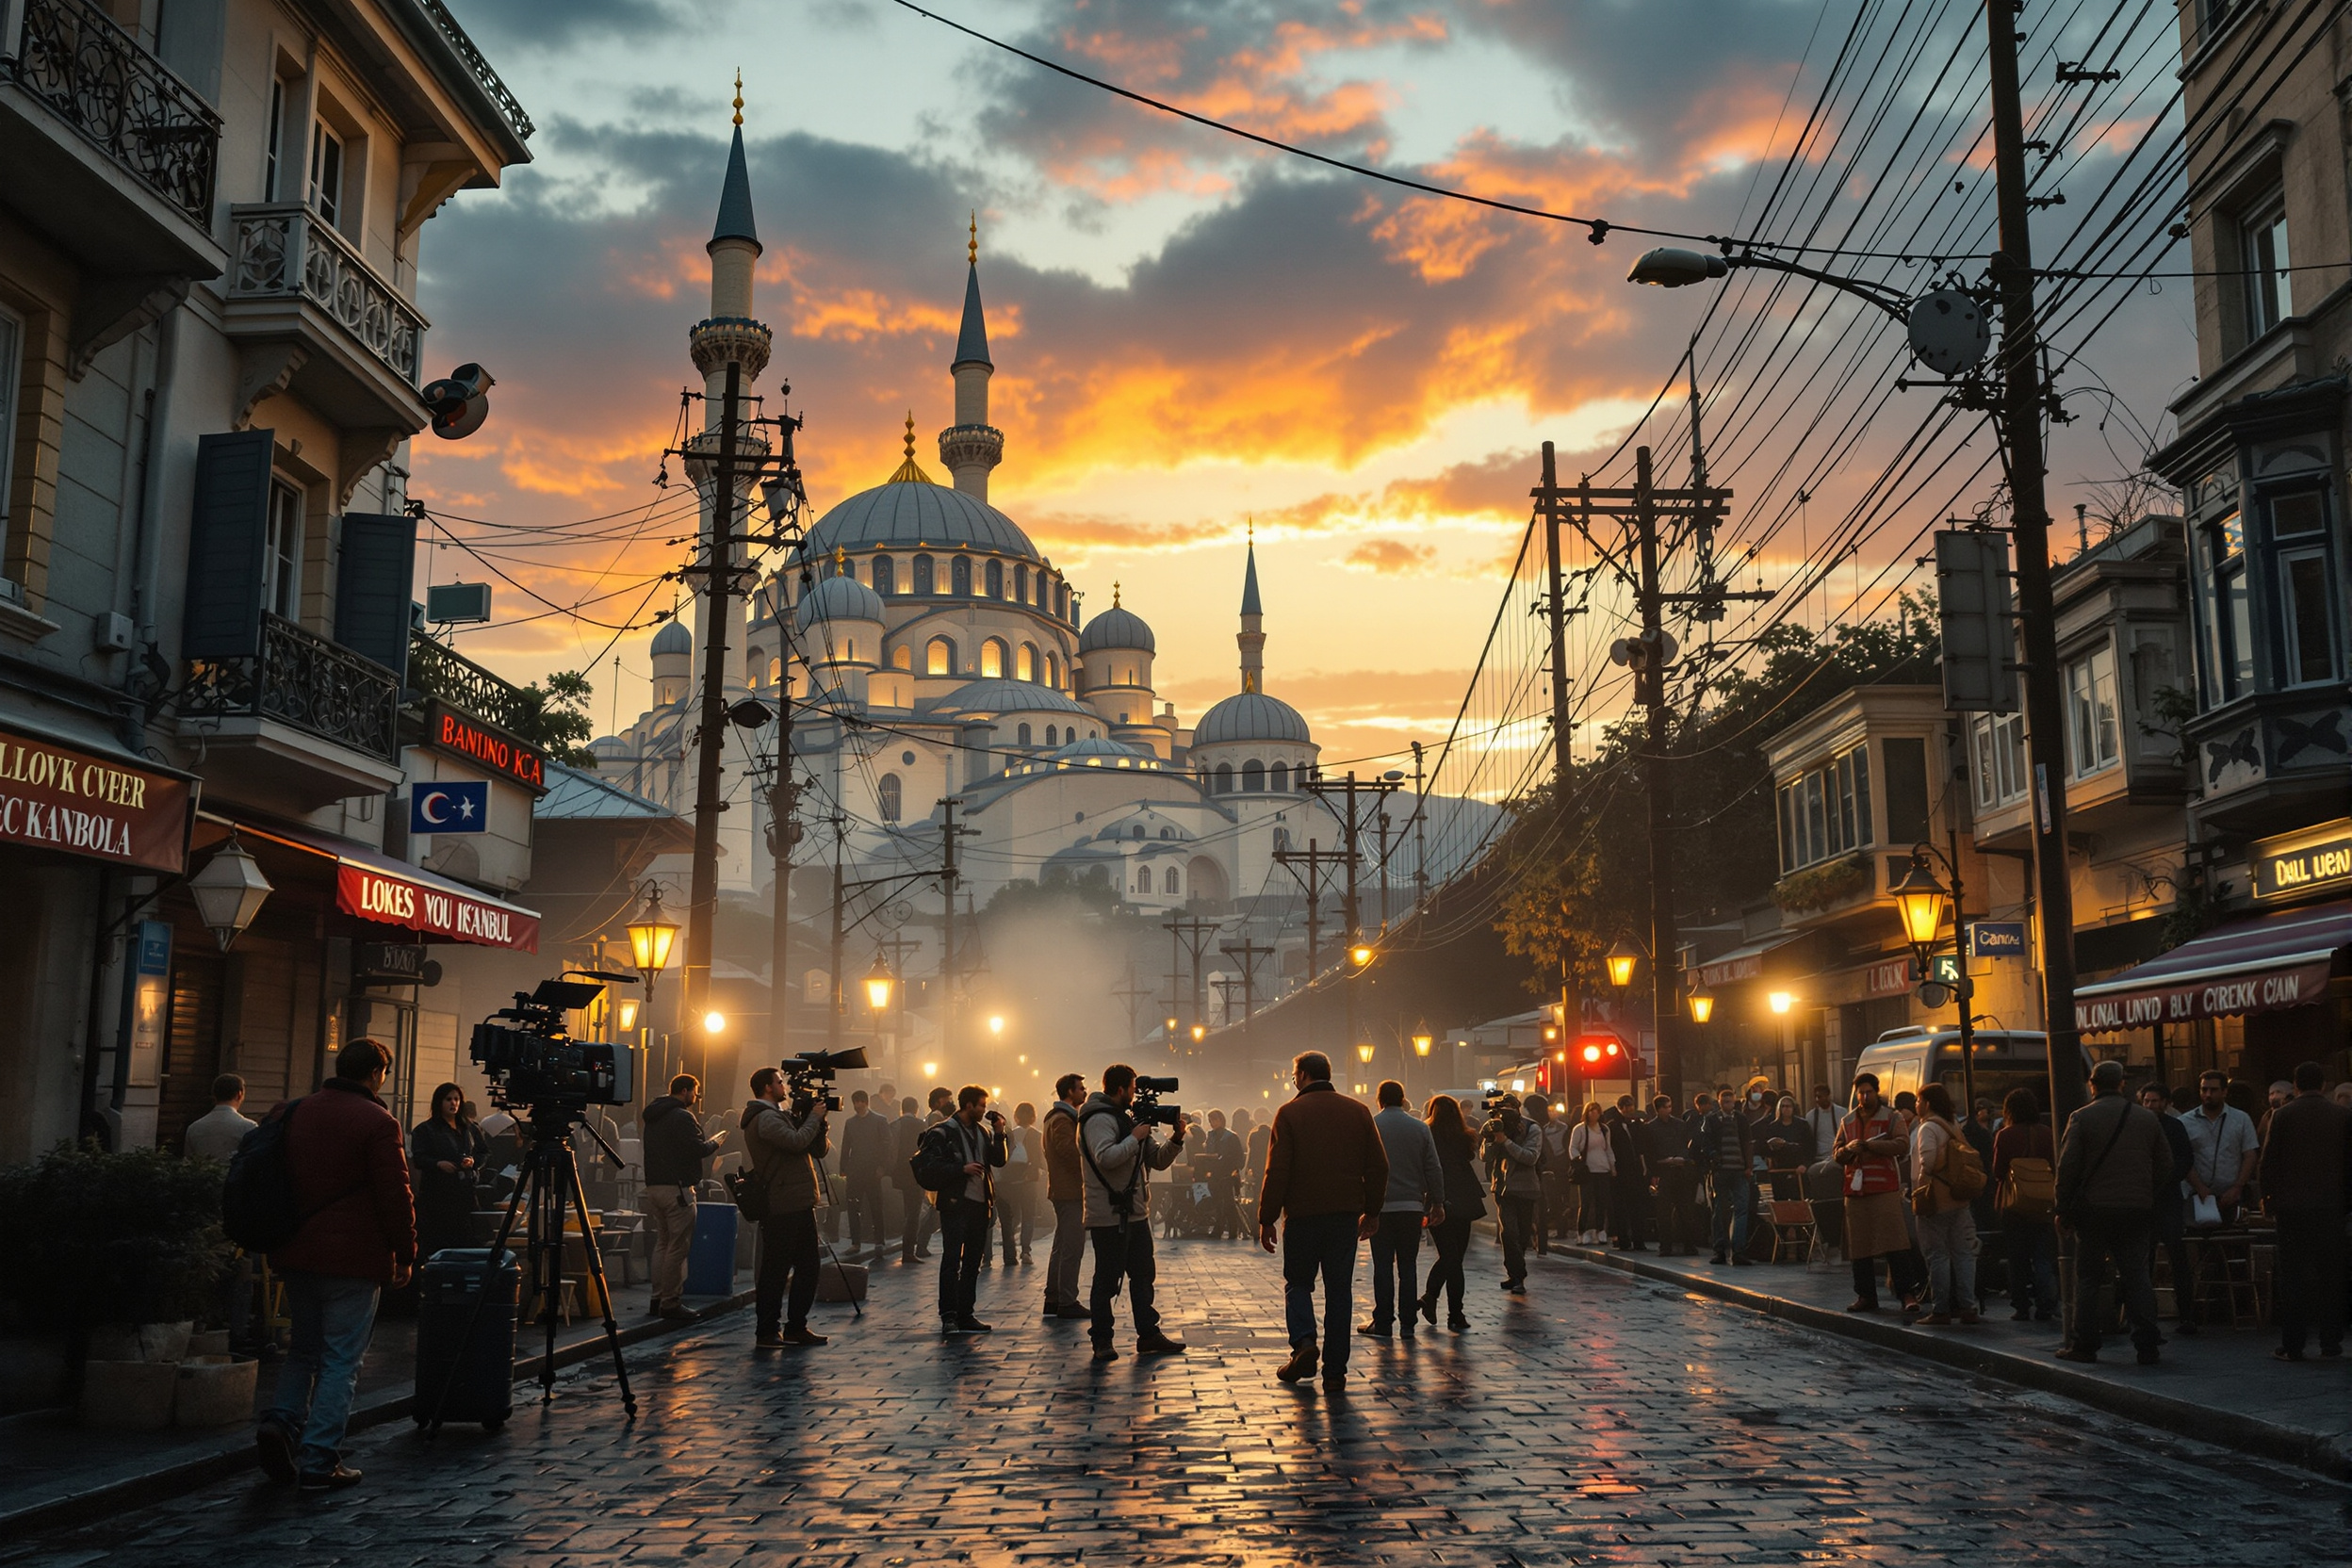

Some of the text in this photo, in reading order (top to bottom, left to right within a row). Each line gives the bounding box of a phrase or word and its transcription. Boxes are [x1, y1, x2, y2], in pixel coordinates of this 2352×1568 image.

[82, 764, 146, 809] CVEER
[24, 801, 132, 857] KANBOLA
[361, 876, 415, 919] LOKES
[424, 892, 452, 930] YOU
